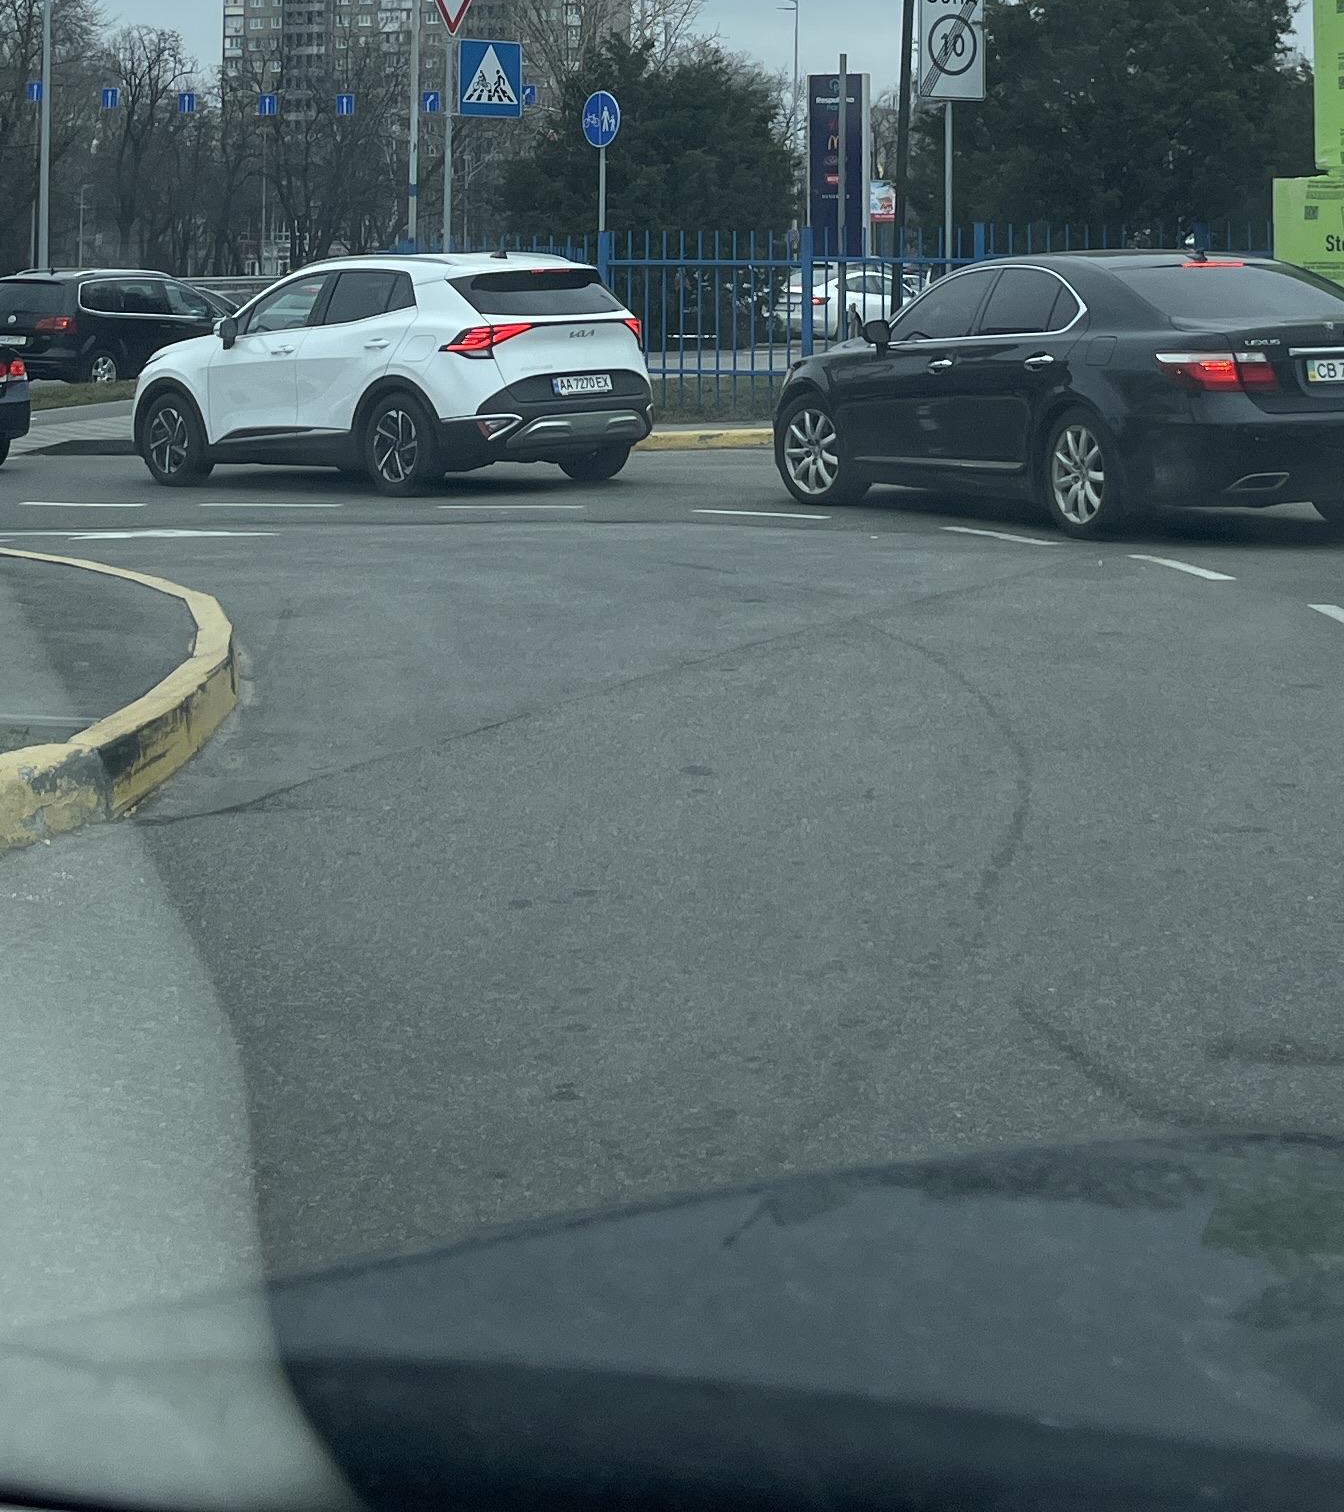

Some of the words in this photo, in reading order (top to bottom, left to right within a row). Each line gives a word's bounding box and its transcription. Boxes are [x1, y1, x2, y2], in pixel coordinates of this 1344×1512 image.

[940, 32, 965, 58] 10
[1317, 362, 1337, 379] CB
[560, 379, 573, 391] AA
[575, 377, 595, 390] 7270
[597, 376, 609, 388] EX
